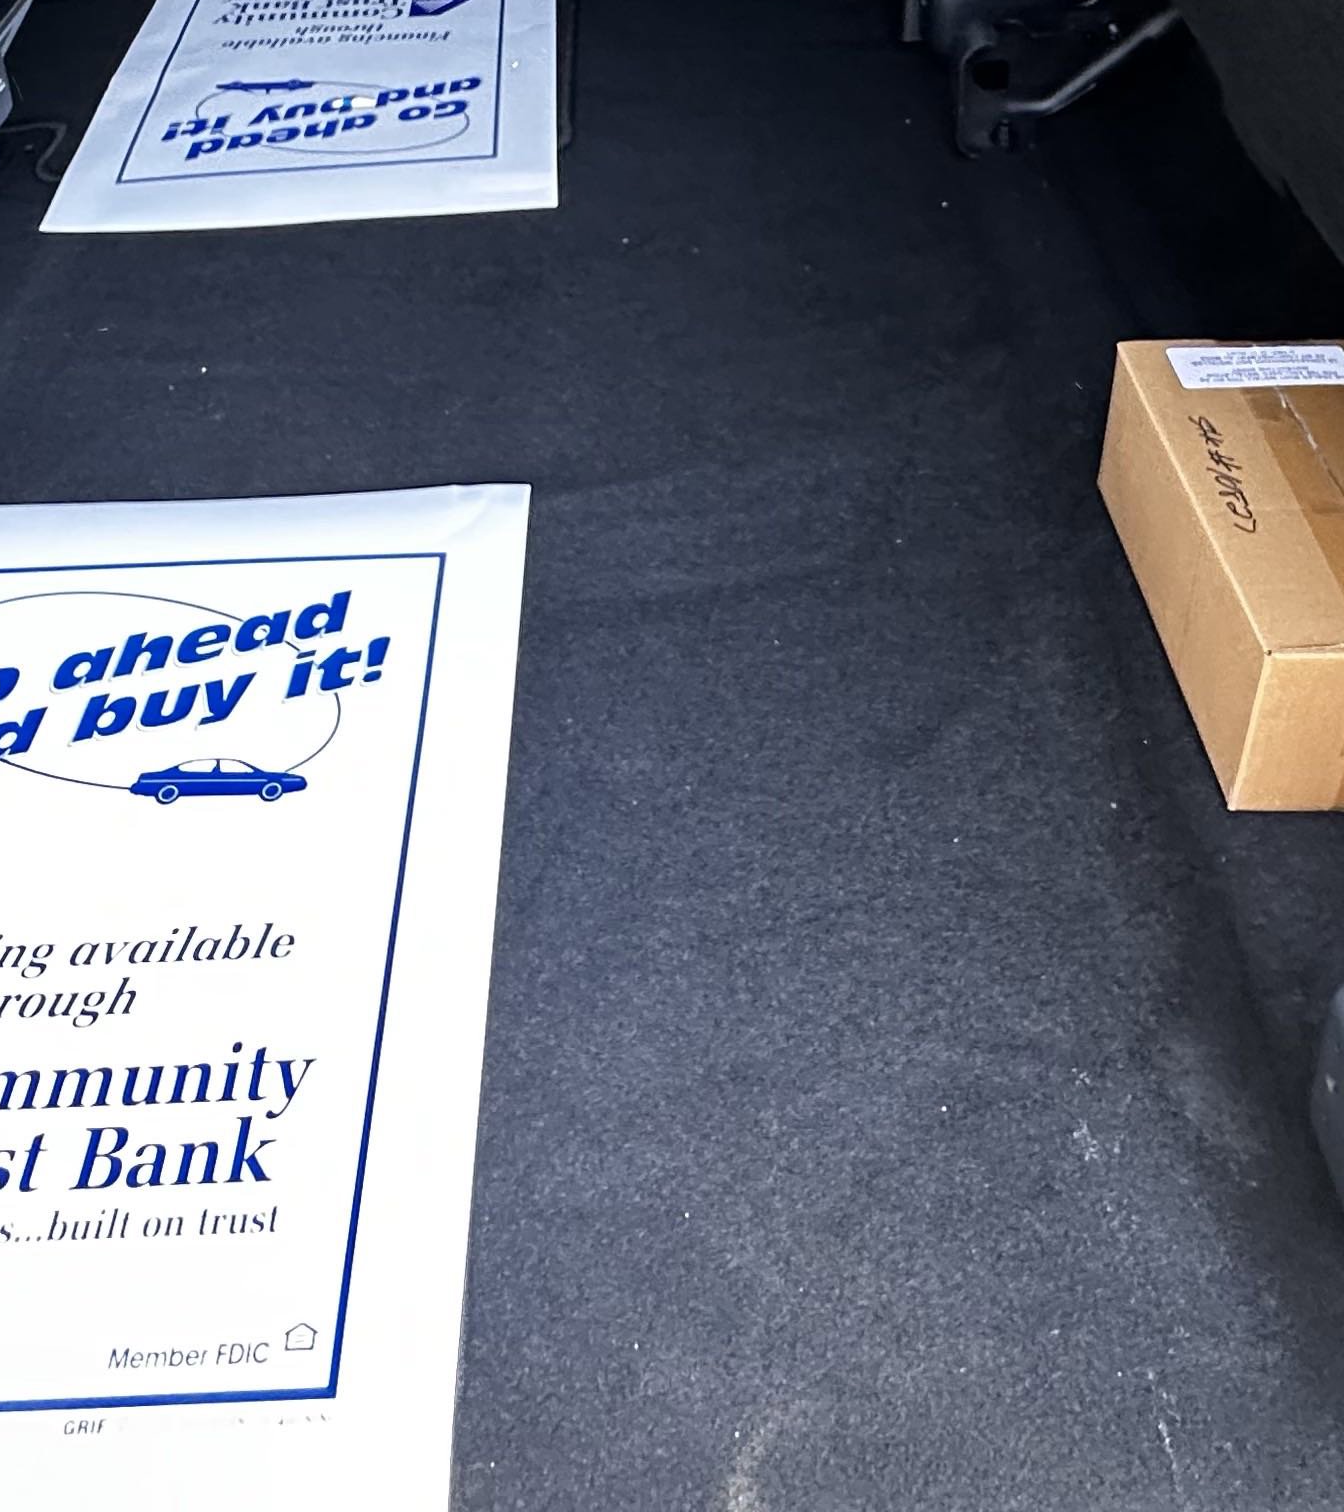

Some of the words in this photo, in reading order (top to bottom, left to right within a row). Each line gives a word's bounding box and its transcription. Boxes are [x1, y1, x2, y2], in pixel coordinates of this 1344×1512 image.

[212, 7, 404, 26] Community
[374, 76, 482, 109] and
[248, 95, 355, 127] buy
[398, 99, 468, 121] Go
[161, 114, 231, 141] it!
[184, 112, 377, 161] ahead
[51, 589, 353, 691] ahead
[70, 671, 258, 744] buy
[284, 636, 391, 700] it!
[68, 922, 296, 967] available
[68, 1116, 278, 1190] Bank
[142, 1216, 185, 1238] on
[198, 1205, 279, 1236] trust
[108, 1346, 208, 1370] Member
[216, 1342, 270, 1366] FDIC
